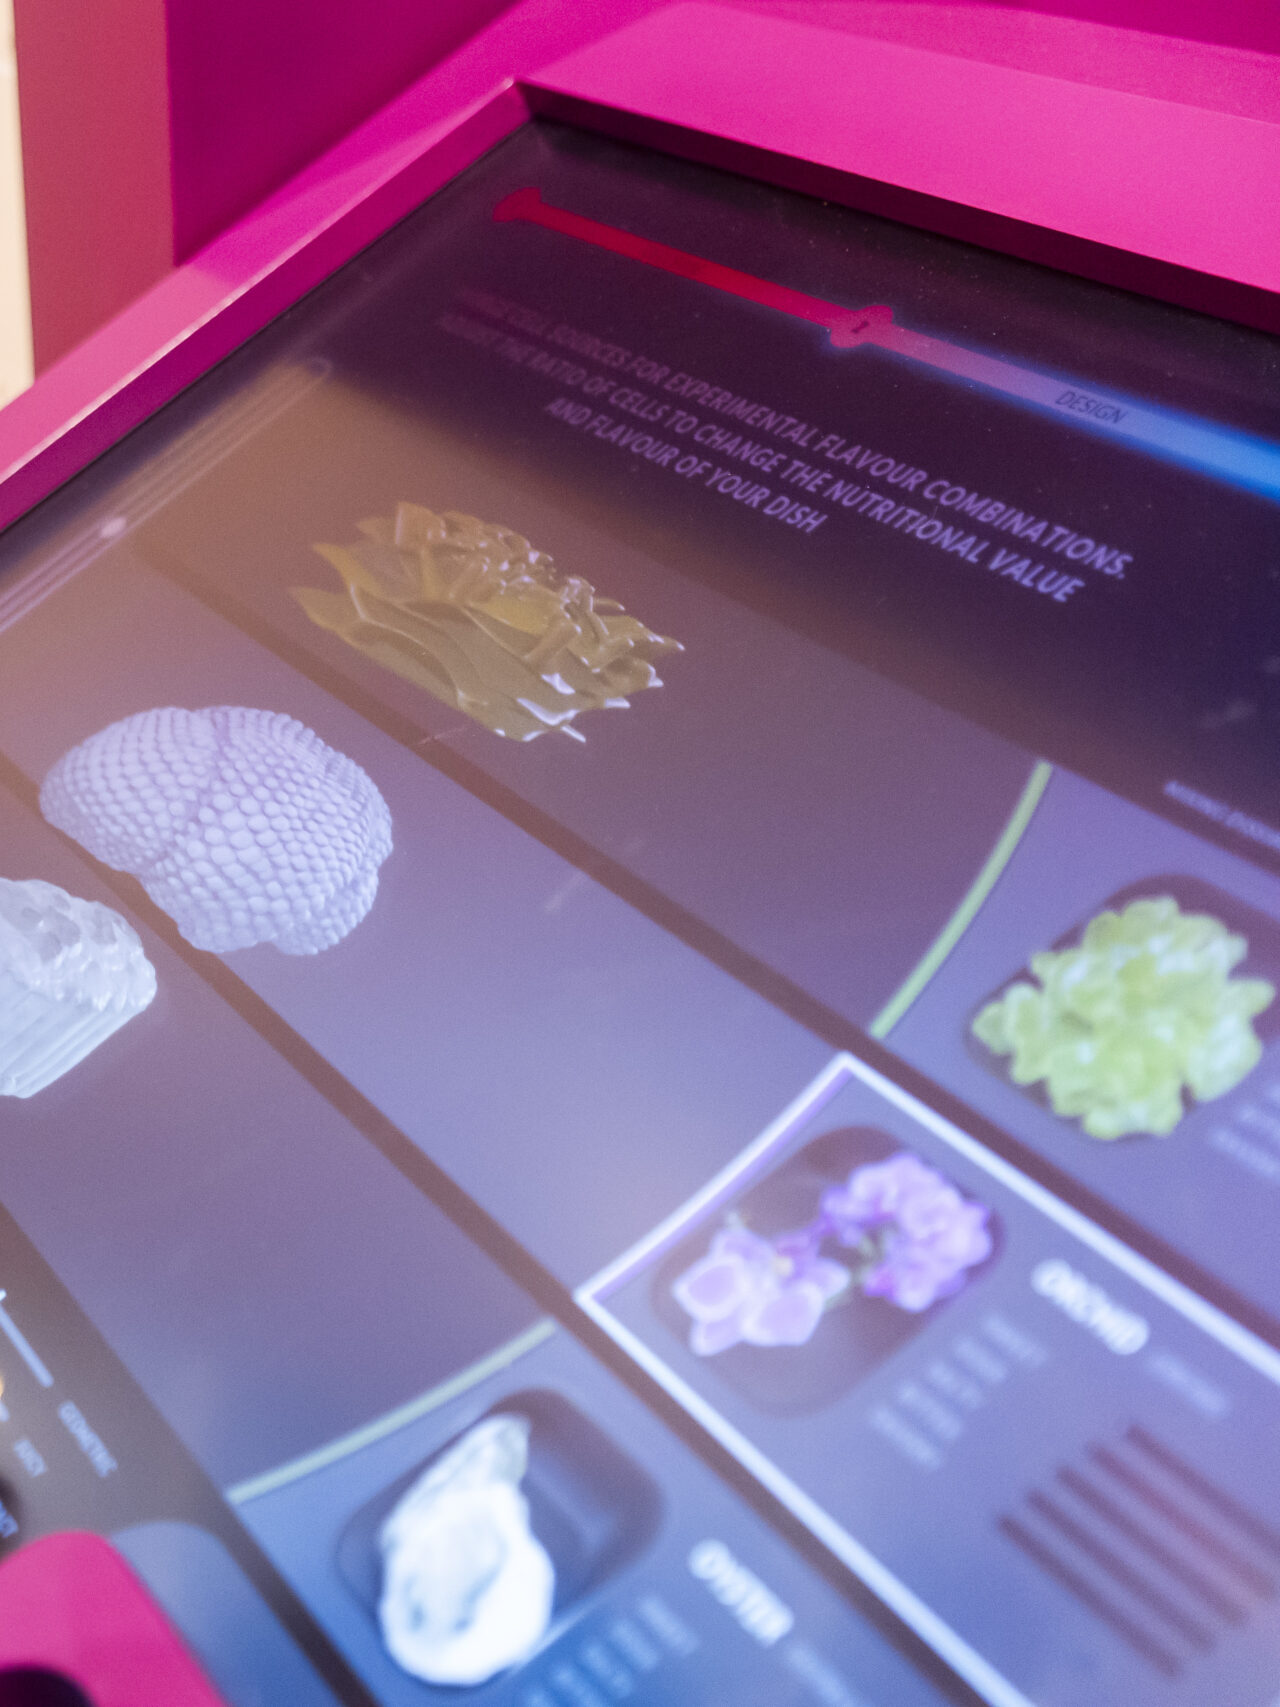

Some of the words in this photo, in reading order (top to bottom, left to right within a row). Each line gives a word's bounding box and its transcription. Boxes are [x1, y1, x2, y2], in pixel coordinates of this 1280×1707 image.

[526, 350, 587, 386] RATIO
[581, 376, 617, 397] OF
[608, 386, 670, 422] CELLS
[664, 408, 699, 434] TO
[693, 423, 788, 473] CHANGE
[780, 459, 833, 493] THE
[822, 478, 990, 563] NUTRITIONAL
[988, 548, 1086, 603] VALUE
[545, 397, 592, 425] AND
[583, 414, 680, 468] FLAVOUR
[674, 455, 712, 478] OF
[705, 467, 771, 509] YOUR
[762, 495, 828, 533] DISH
[624, 355, 670, 385] FOR
[663, 372, 817, 448] EXPERIMENTAL
[812, 433, 928, 492] FLAVOUR
[922, 479, 1134, 579] COMBINATIONS.
[1054, 389, 1128, 425] DESIGN
